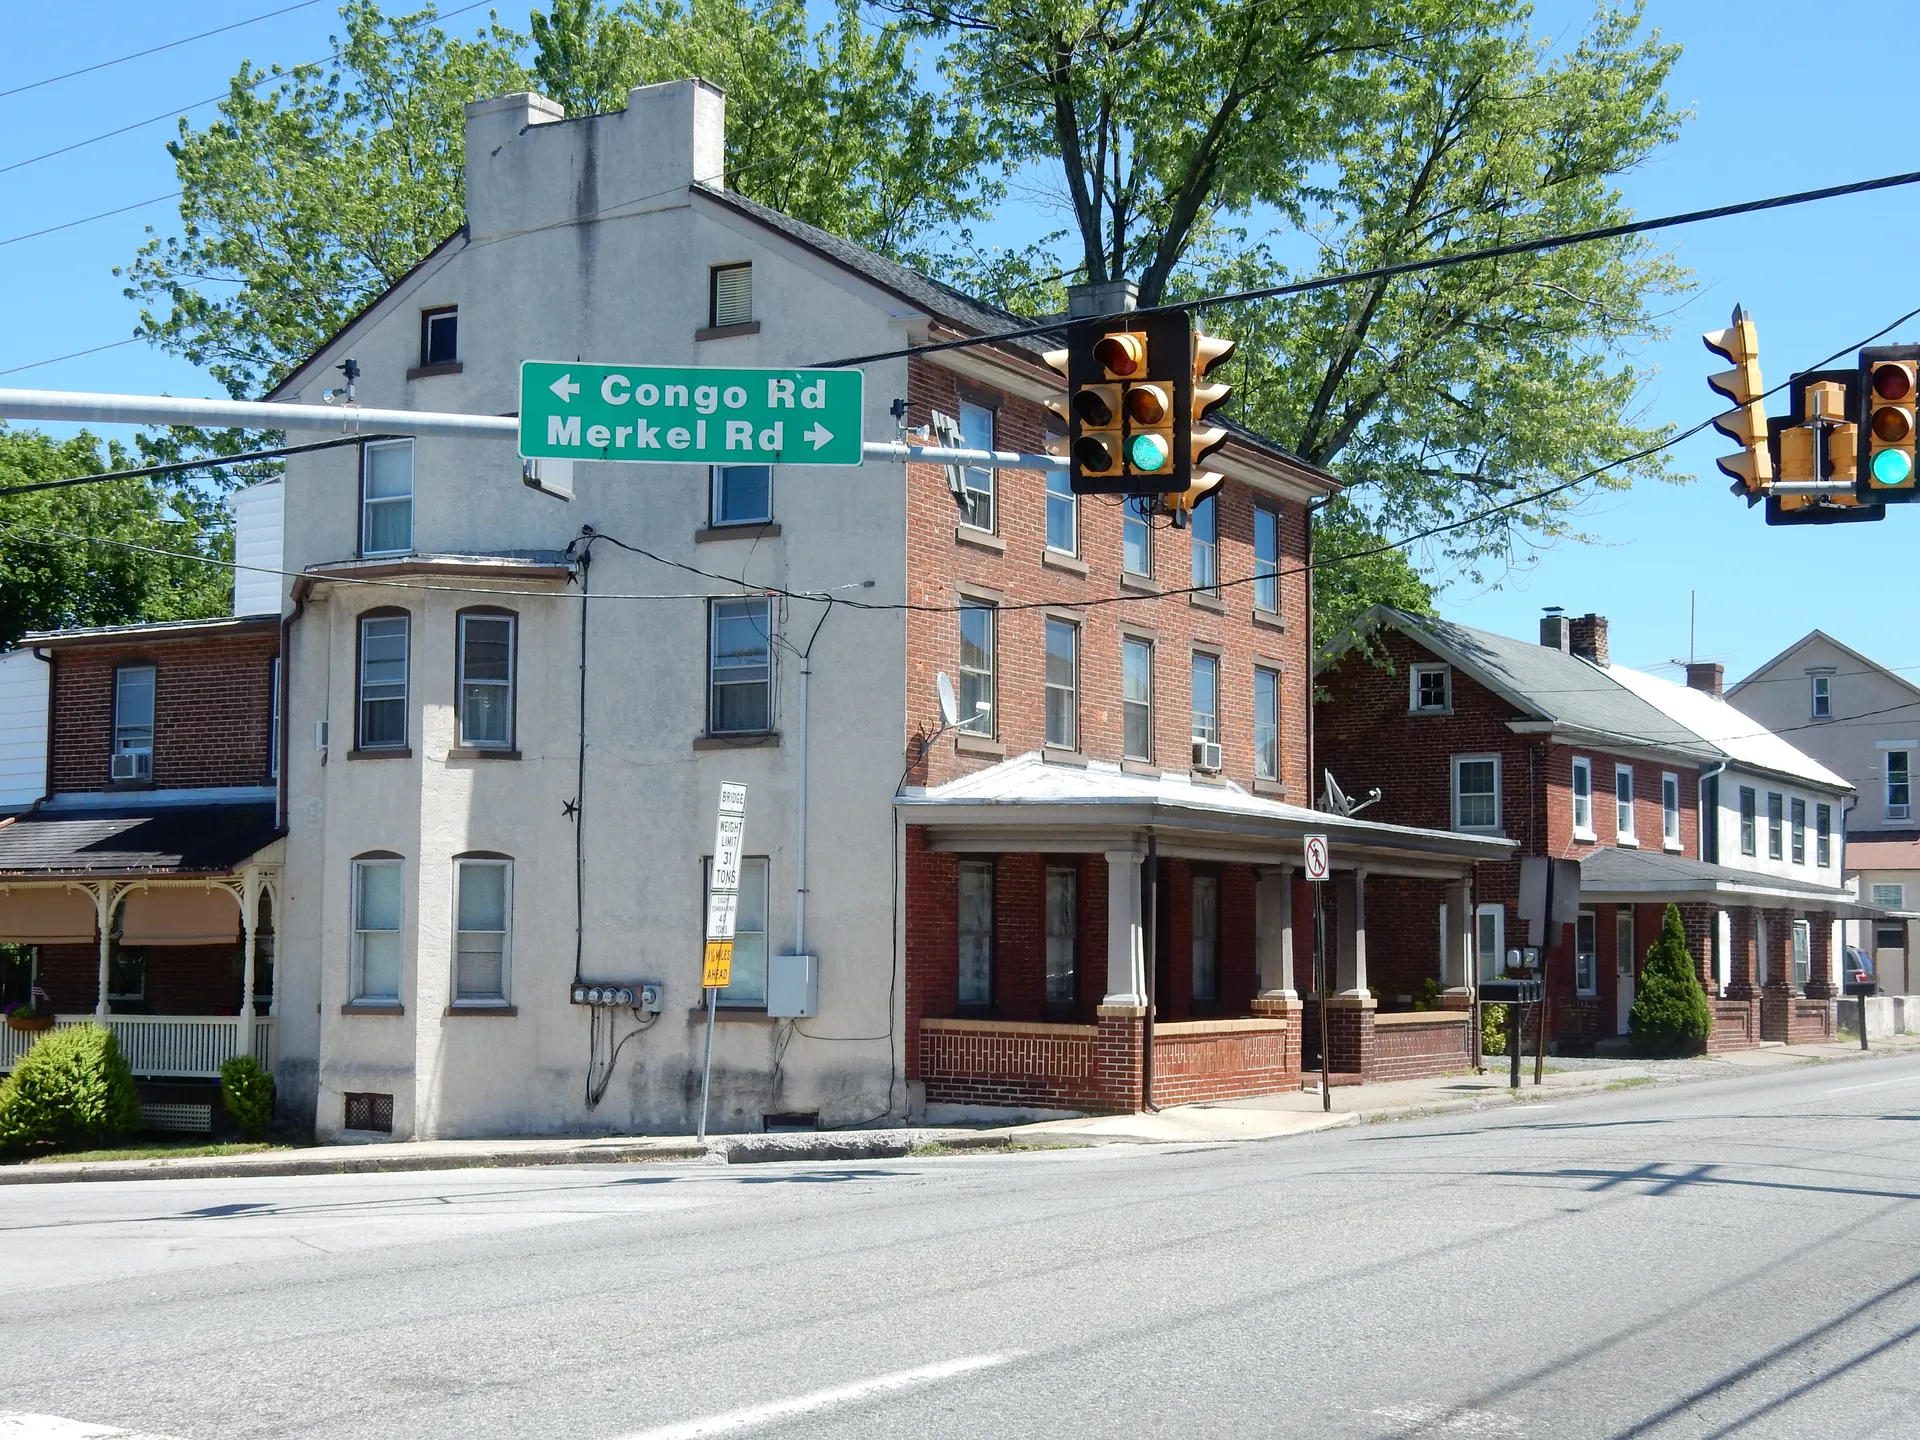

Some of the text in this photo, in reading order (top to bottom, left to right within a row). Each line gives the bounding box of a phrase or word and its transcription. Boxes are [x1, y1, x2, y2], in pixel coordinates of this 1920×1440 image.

[600, 374, 826, 414] Congo Rd
[547, 415, 783, 451] Merkel Rd
[722, 791, 743, 804] BRIDGE
[720, 821, 742, 833] WEIGHT
[721, 836, 737, 847] LIMIT
[723, 852, 732, 865] 31
[716, 870, 736, 884] TONS
[716, 926, 728, 935] TONS
[716, 949, 731, 961] MILES
[707, 968, 728, 980] AHEAD
